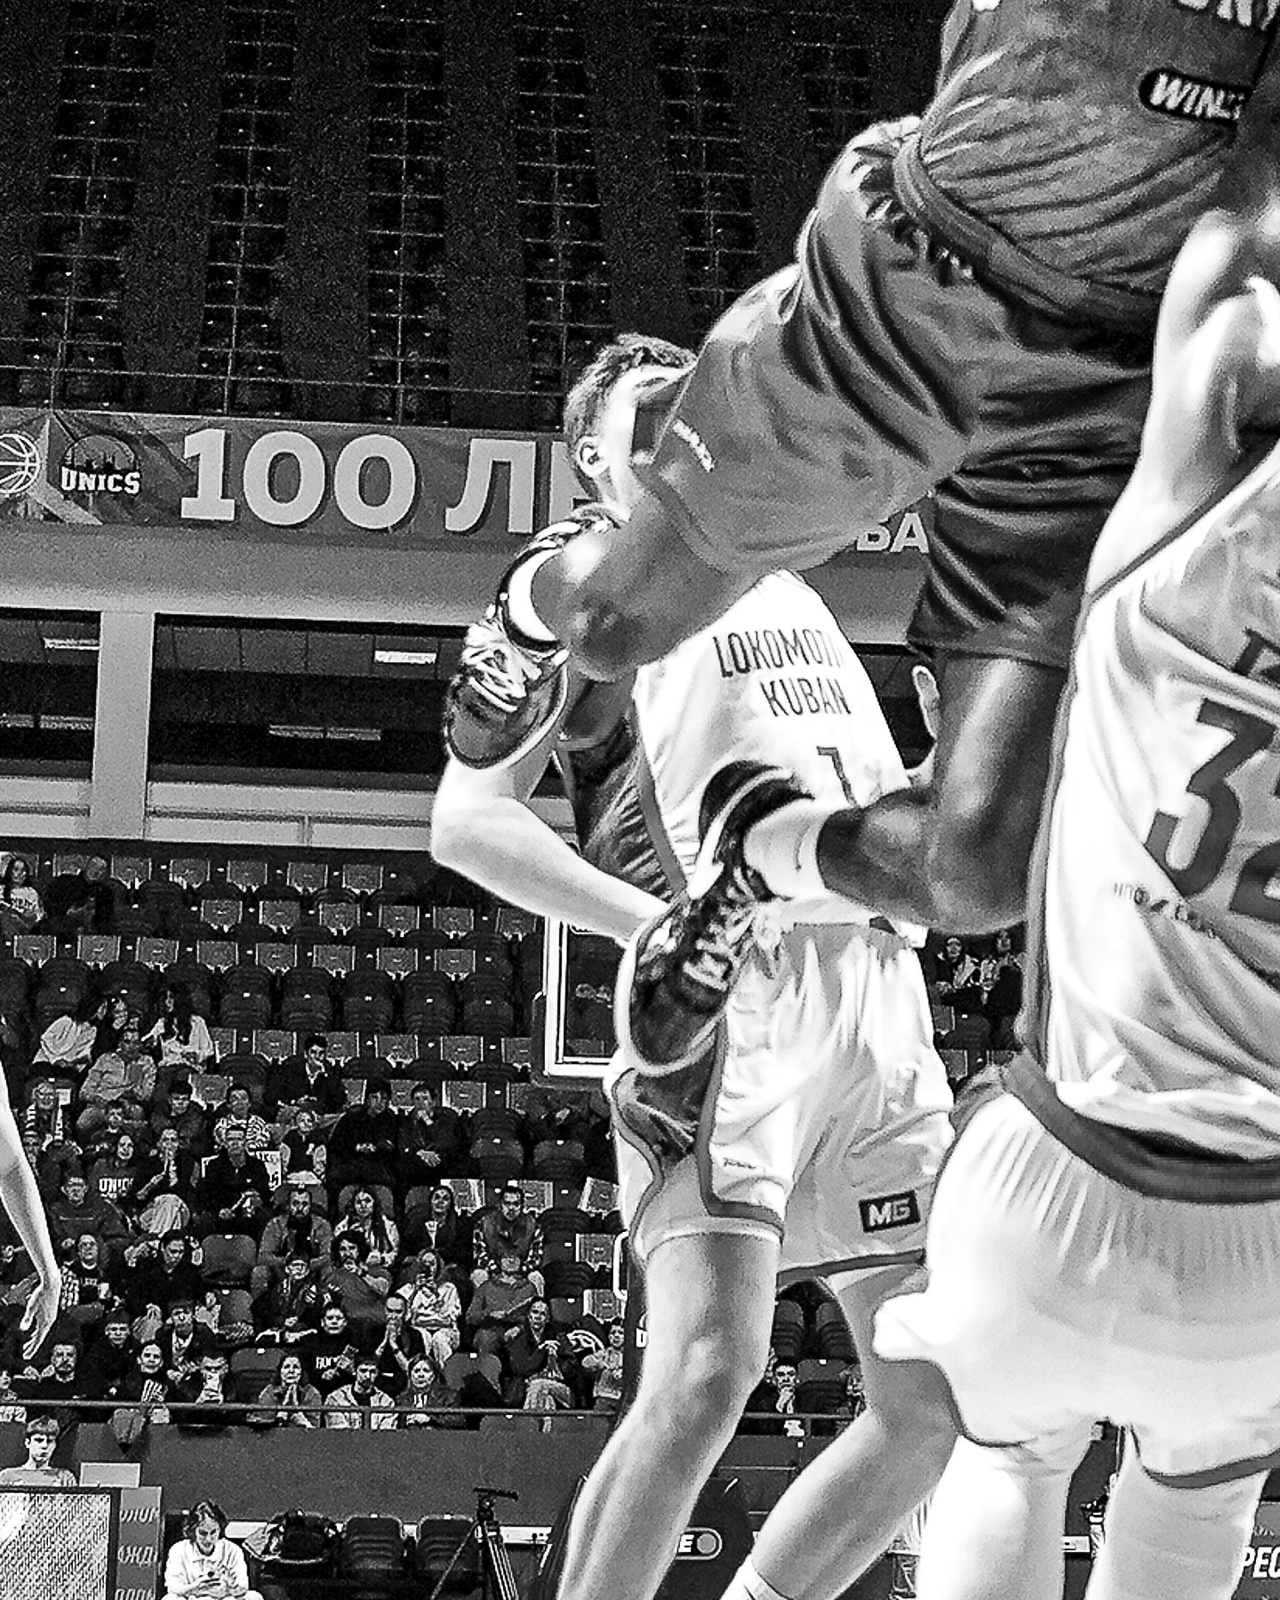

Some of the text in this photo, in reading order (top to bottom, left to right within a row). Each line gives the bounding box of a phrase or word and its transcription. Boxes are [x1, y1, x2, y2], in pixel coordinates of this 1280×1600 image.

[61, 465, 141, 494] UNICS
[181, 427, 417, 532] 100
[712, 628, 847, 678] LOKOMOTI
[759, 676, 851, 717] KUBAN
